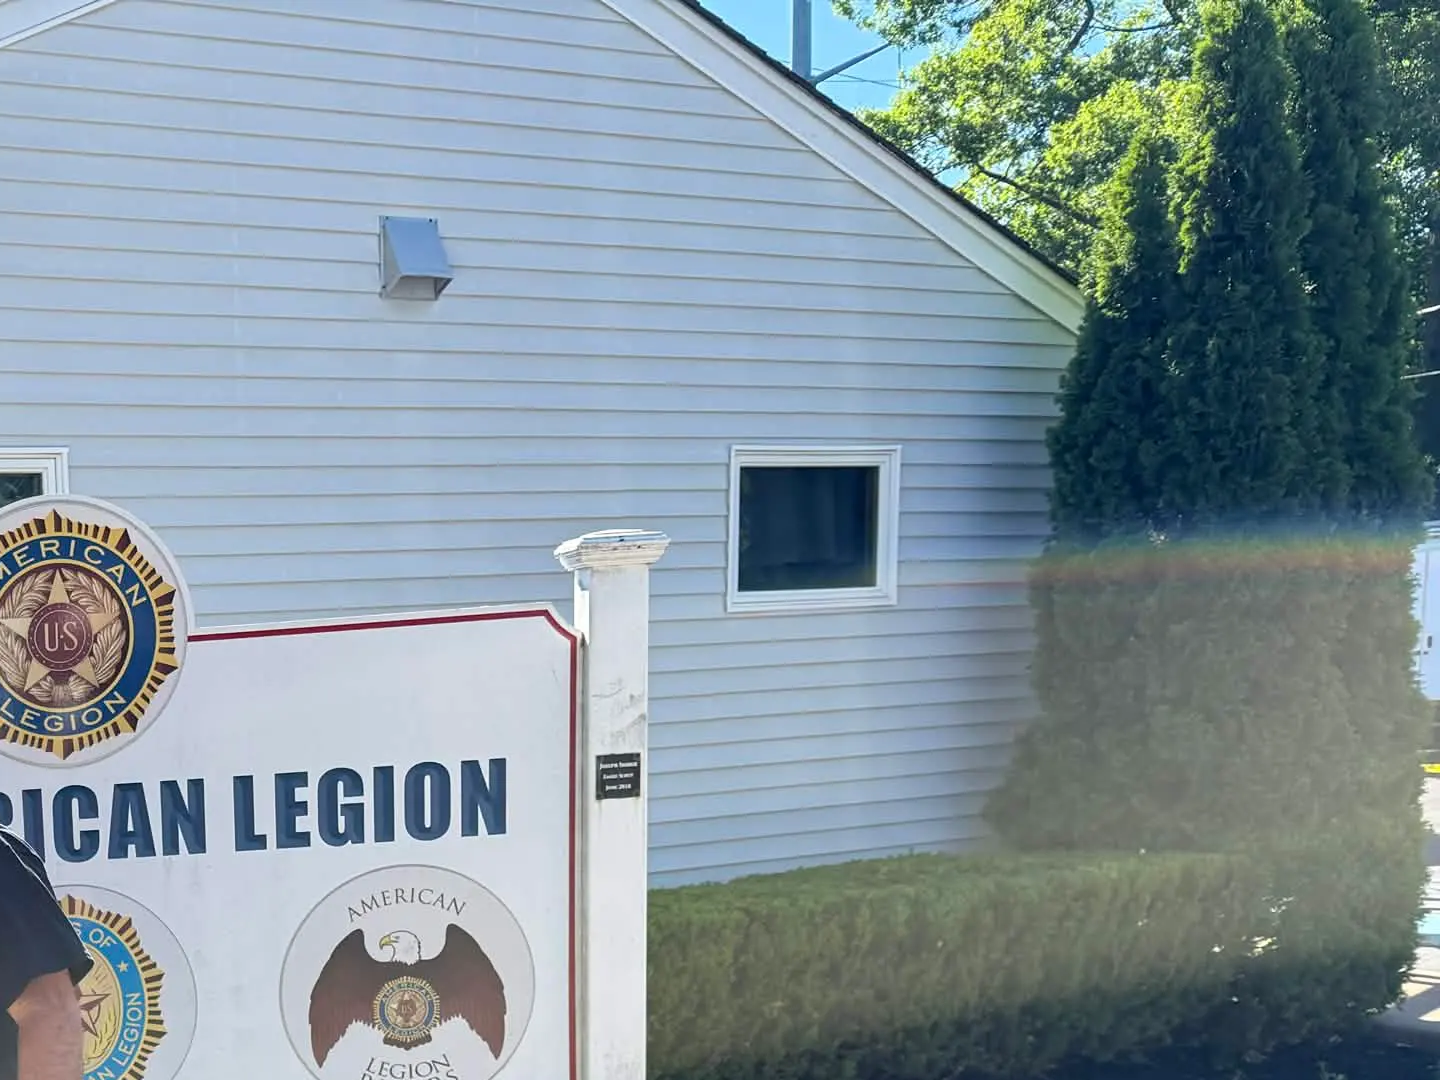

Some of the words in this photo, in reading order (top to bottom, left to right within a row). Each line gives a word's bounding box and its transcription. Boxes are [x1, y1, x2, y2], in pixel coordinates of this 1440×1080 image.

[0, 690, 128, 733] LEGION
[232, 757, 507, 853] LEGION
[346, 887, 467, 923] AMERICAN
[112, 992, 144, 1068] LEGION
[365, 1053, 452, 1080] LEGION
